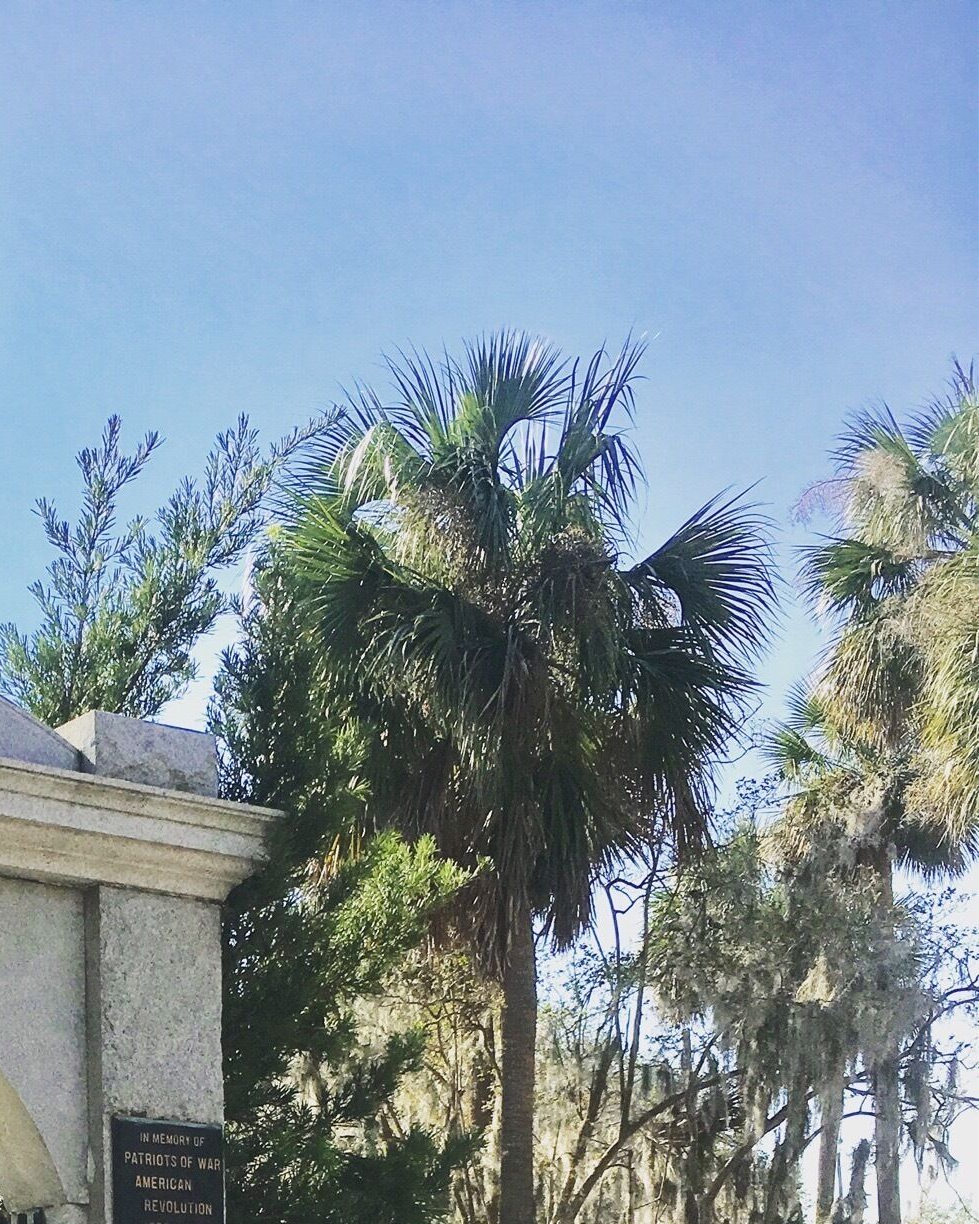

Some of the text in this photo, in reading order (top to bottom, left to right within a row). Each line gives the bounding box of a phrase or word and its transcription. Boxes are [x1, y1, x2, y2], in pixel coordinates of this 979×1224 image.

[139, 1132, 205, 1148] IN MEMORY OF
[124, 1151, 221, 1172] PATRIOTS OF WAR
[135, 1175, 192, 1192] AMERICAN
[144, 1199, 213, 1217] REVOLUTION
